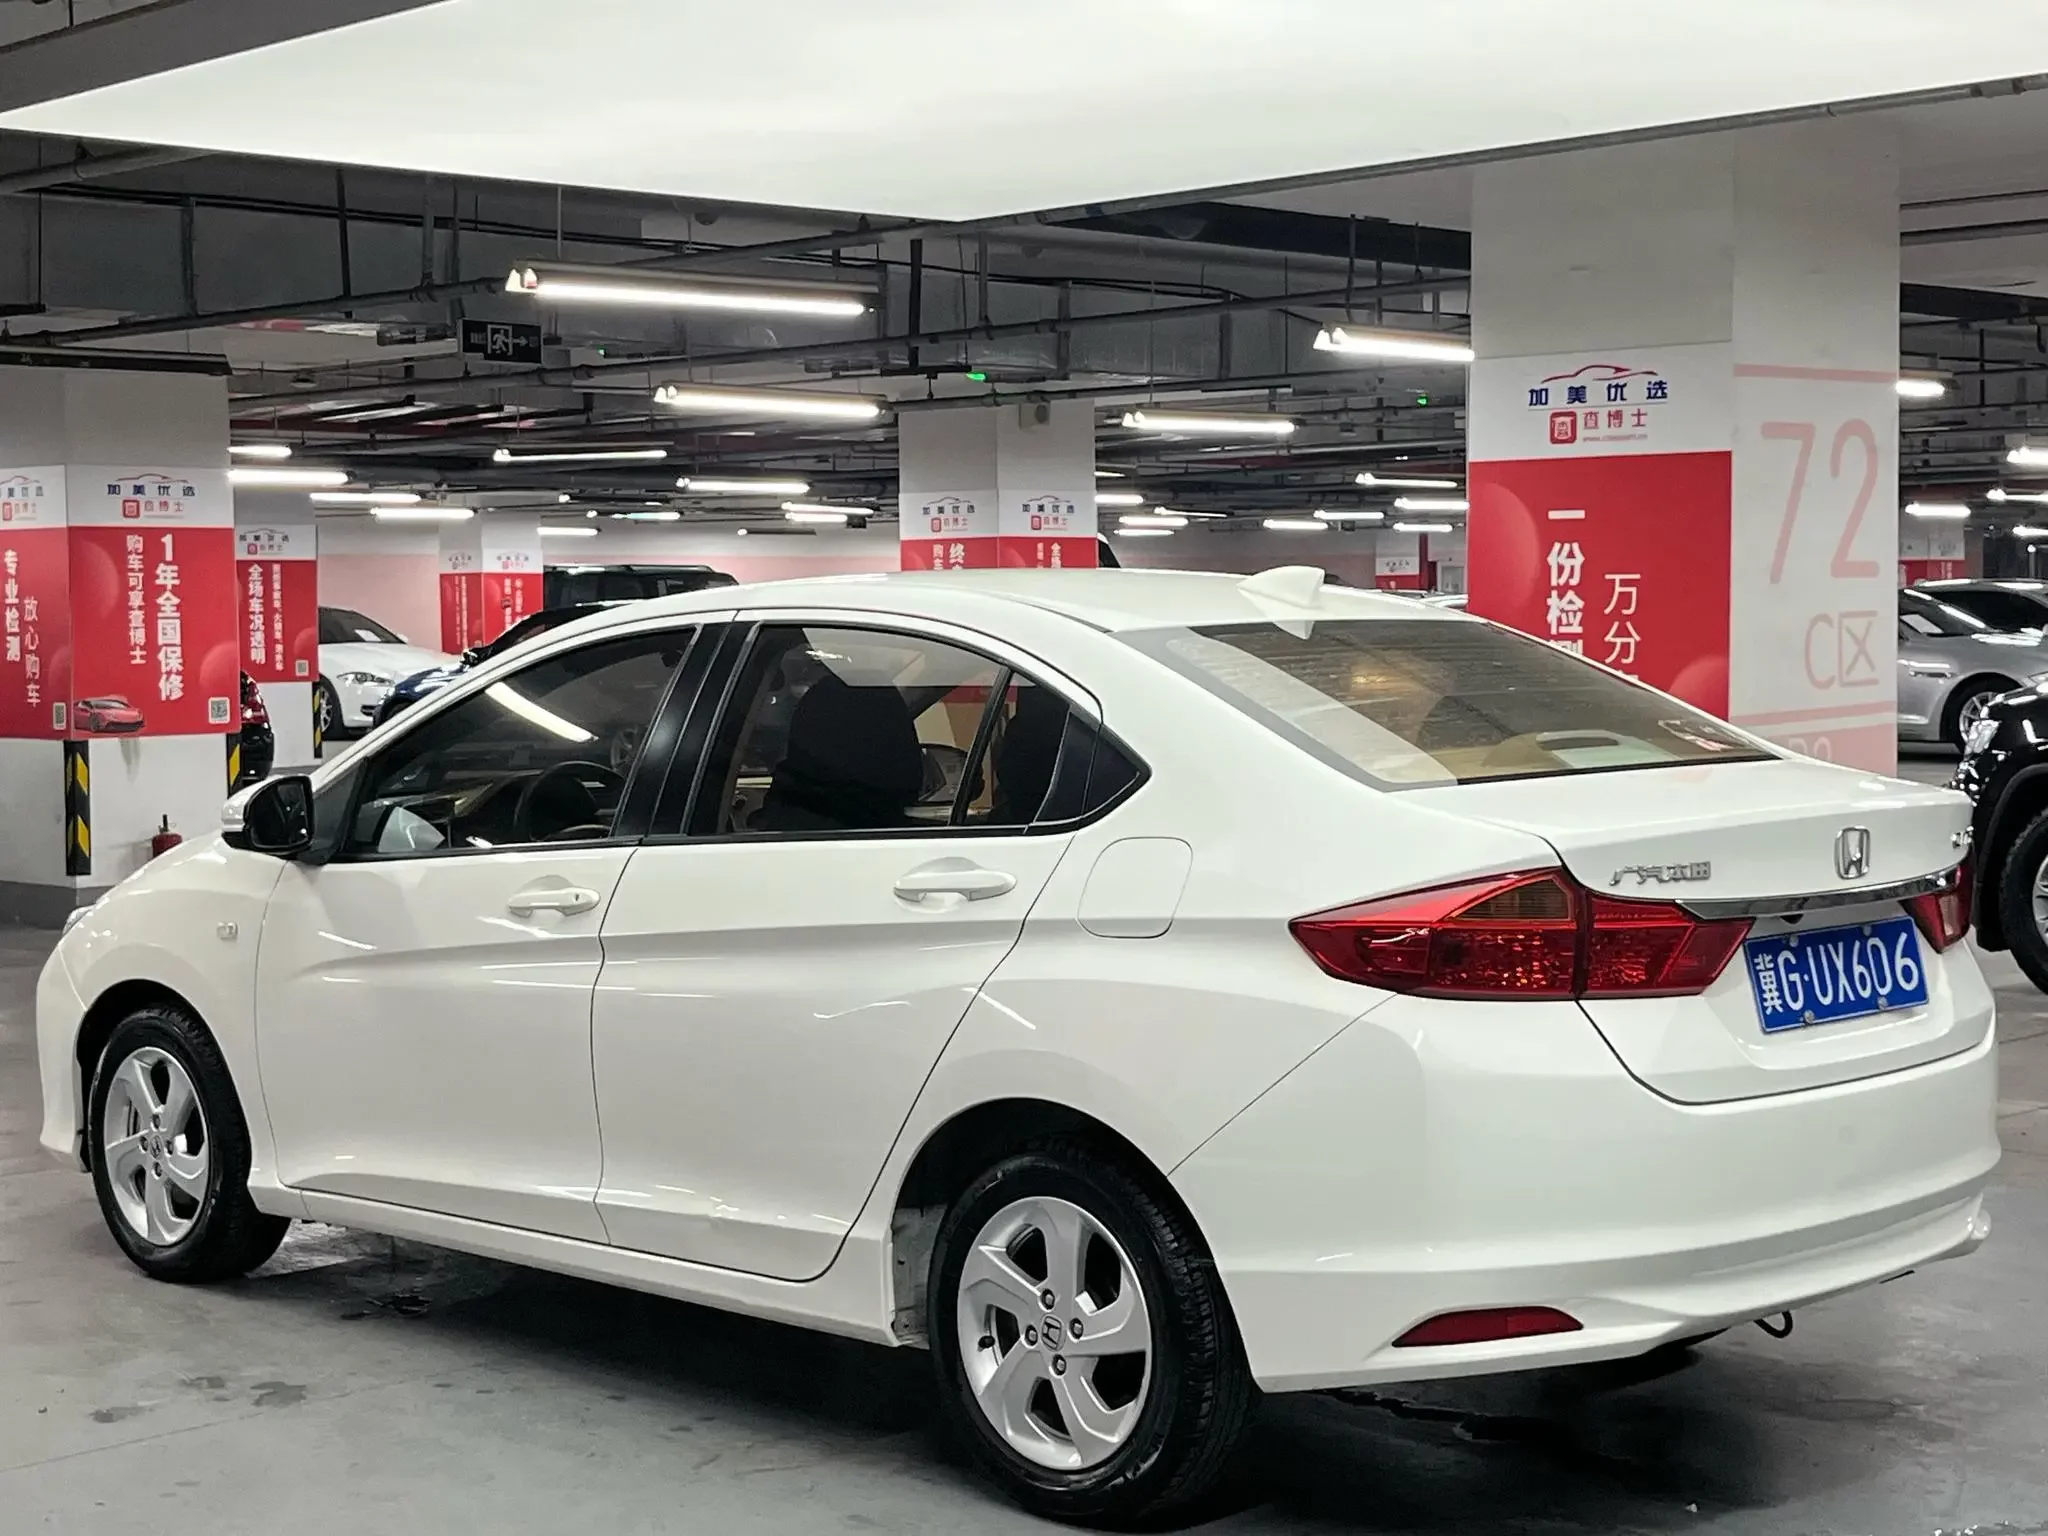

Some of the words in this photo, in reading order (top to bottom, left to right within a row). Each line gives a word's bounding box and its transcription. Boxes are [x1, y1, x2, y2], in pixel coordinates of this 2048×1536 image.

[1528, 379, 1668, 407] 加美优选
[1582, 407, 1648, 430] 查博士
[107, 483, 195, 497] 加美优选
[1760, 418, 1880, 585] 72
[4, 549, 21, 662] 专业检测
[155, 533, 184, 701] 1年全国保修
[1546, 509, 1585, 657] 一份检
[23, 596, 41, 708] 放心购车
[1804, 610, 1880, 690] C区
